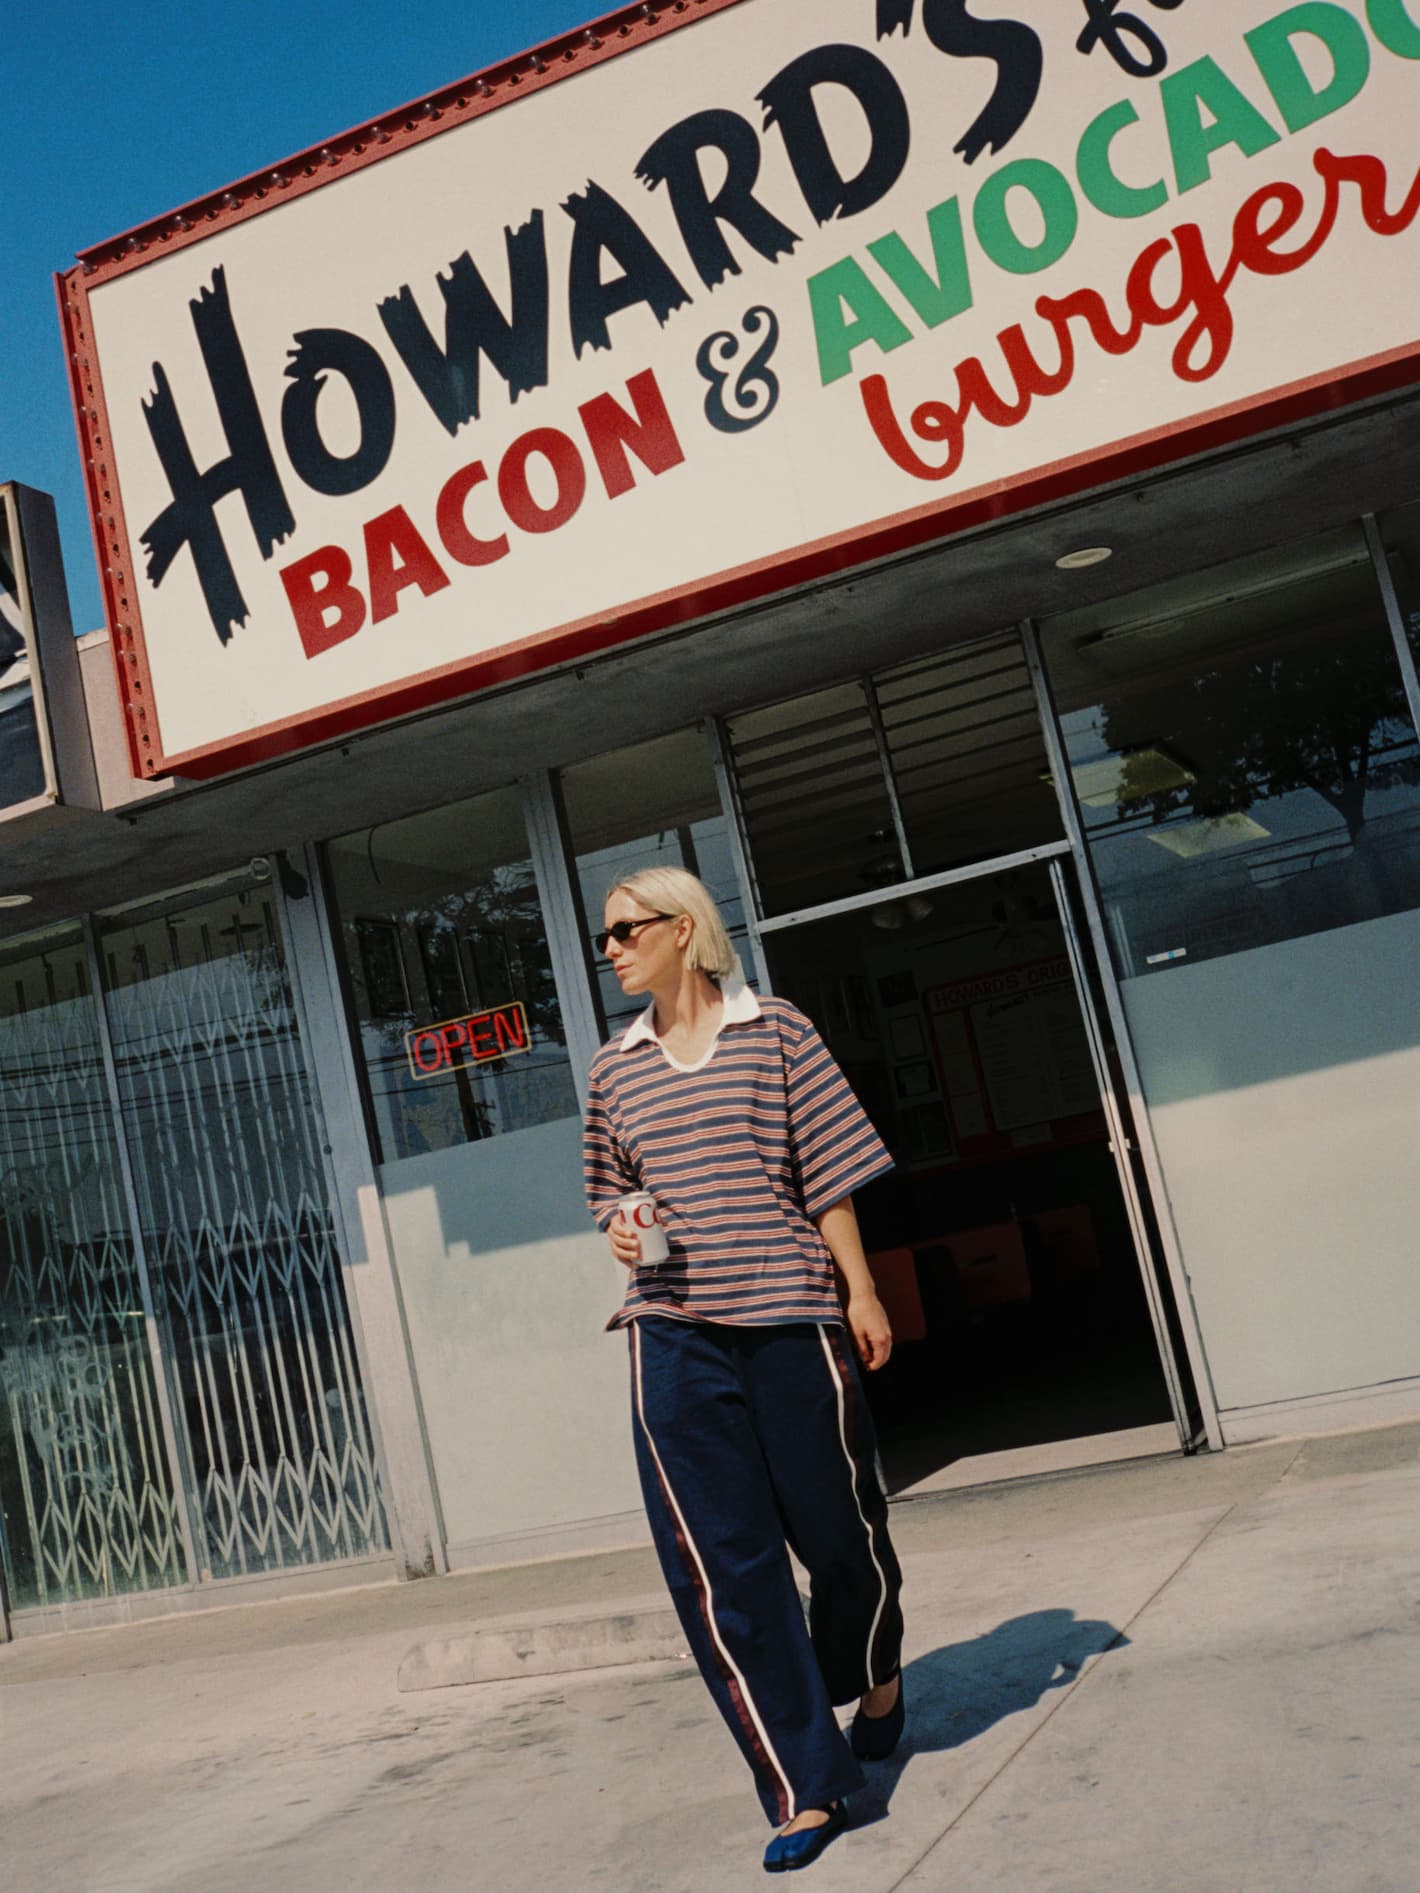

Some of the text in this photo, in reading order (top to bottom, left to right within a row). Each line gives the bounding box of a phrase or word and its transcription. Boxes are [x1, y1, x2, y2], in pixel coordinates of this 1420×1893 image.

[279, 368, 685, 659] BACON
[697, 306, 779, 433] &
[412, 1007, 526, 1072] OPEN
